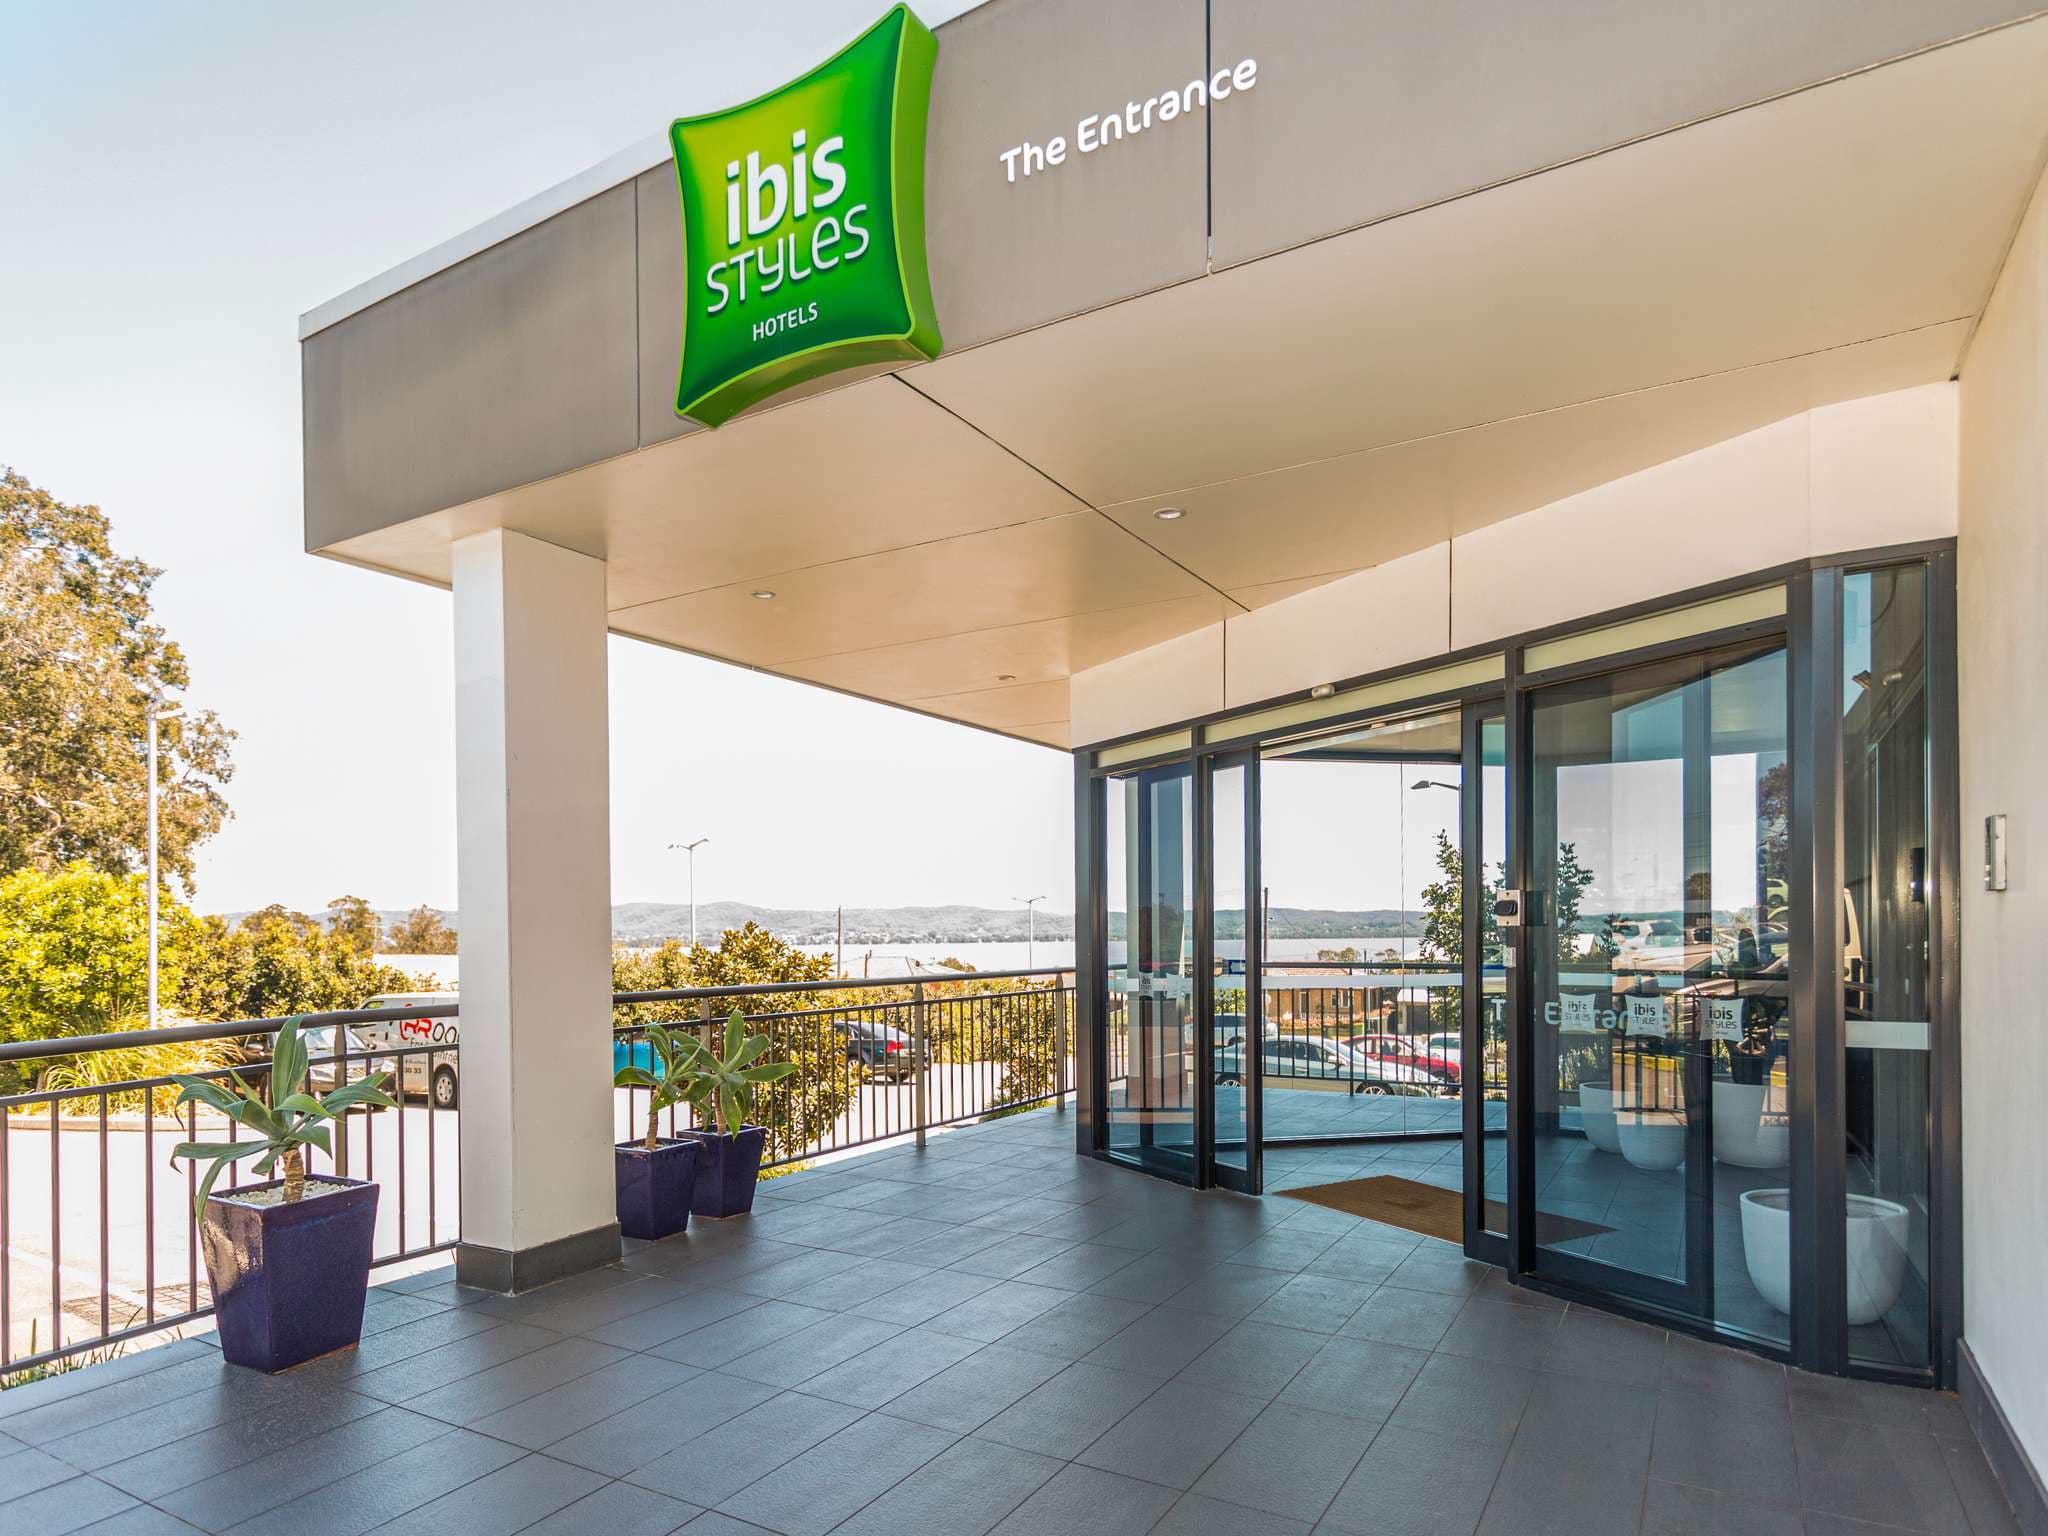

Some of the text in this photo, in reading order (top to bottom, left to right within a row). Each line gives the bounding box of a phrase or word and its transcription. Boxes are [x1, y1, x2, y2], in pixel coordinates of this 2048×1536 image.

[1000, 59, 1257, 182] The Entrance
[726, 129, 847, 246] ibis
[706, 204, 870, 313] STYLES
[752, 302, 819, 342] HOTELS
[1634, 1003, 1656, 1016] ibis
[1709, 1006, 1733, 1020] ibis
